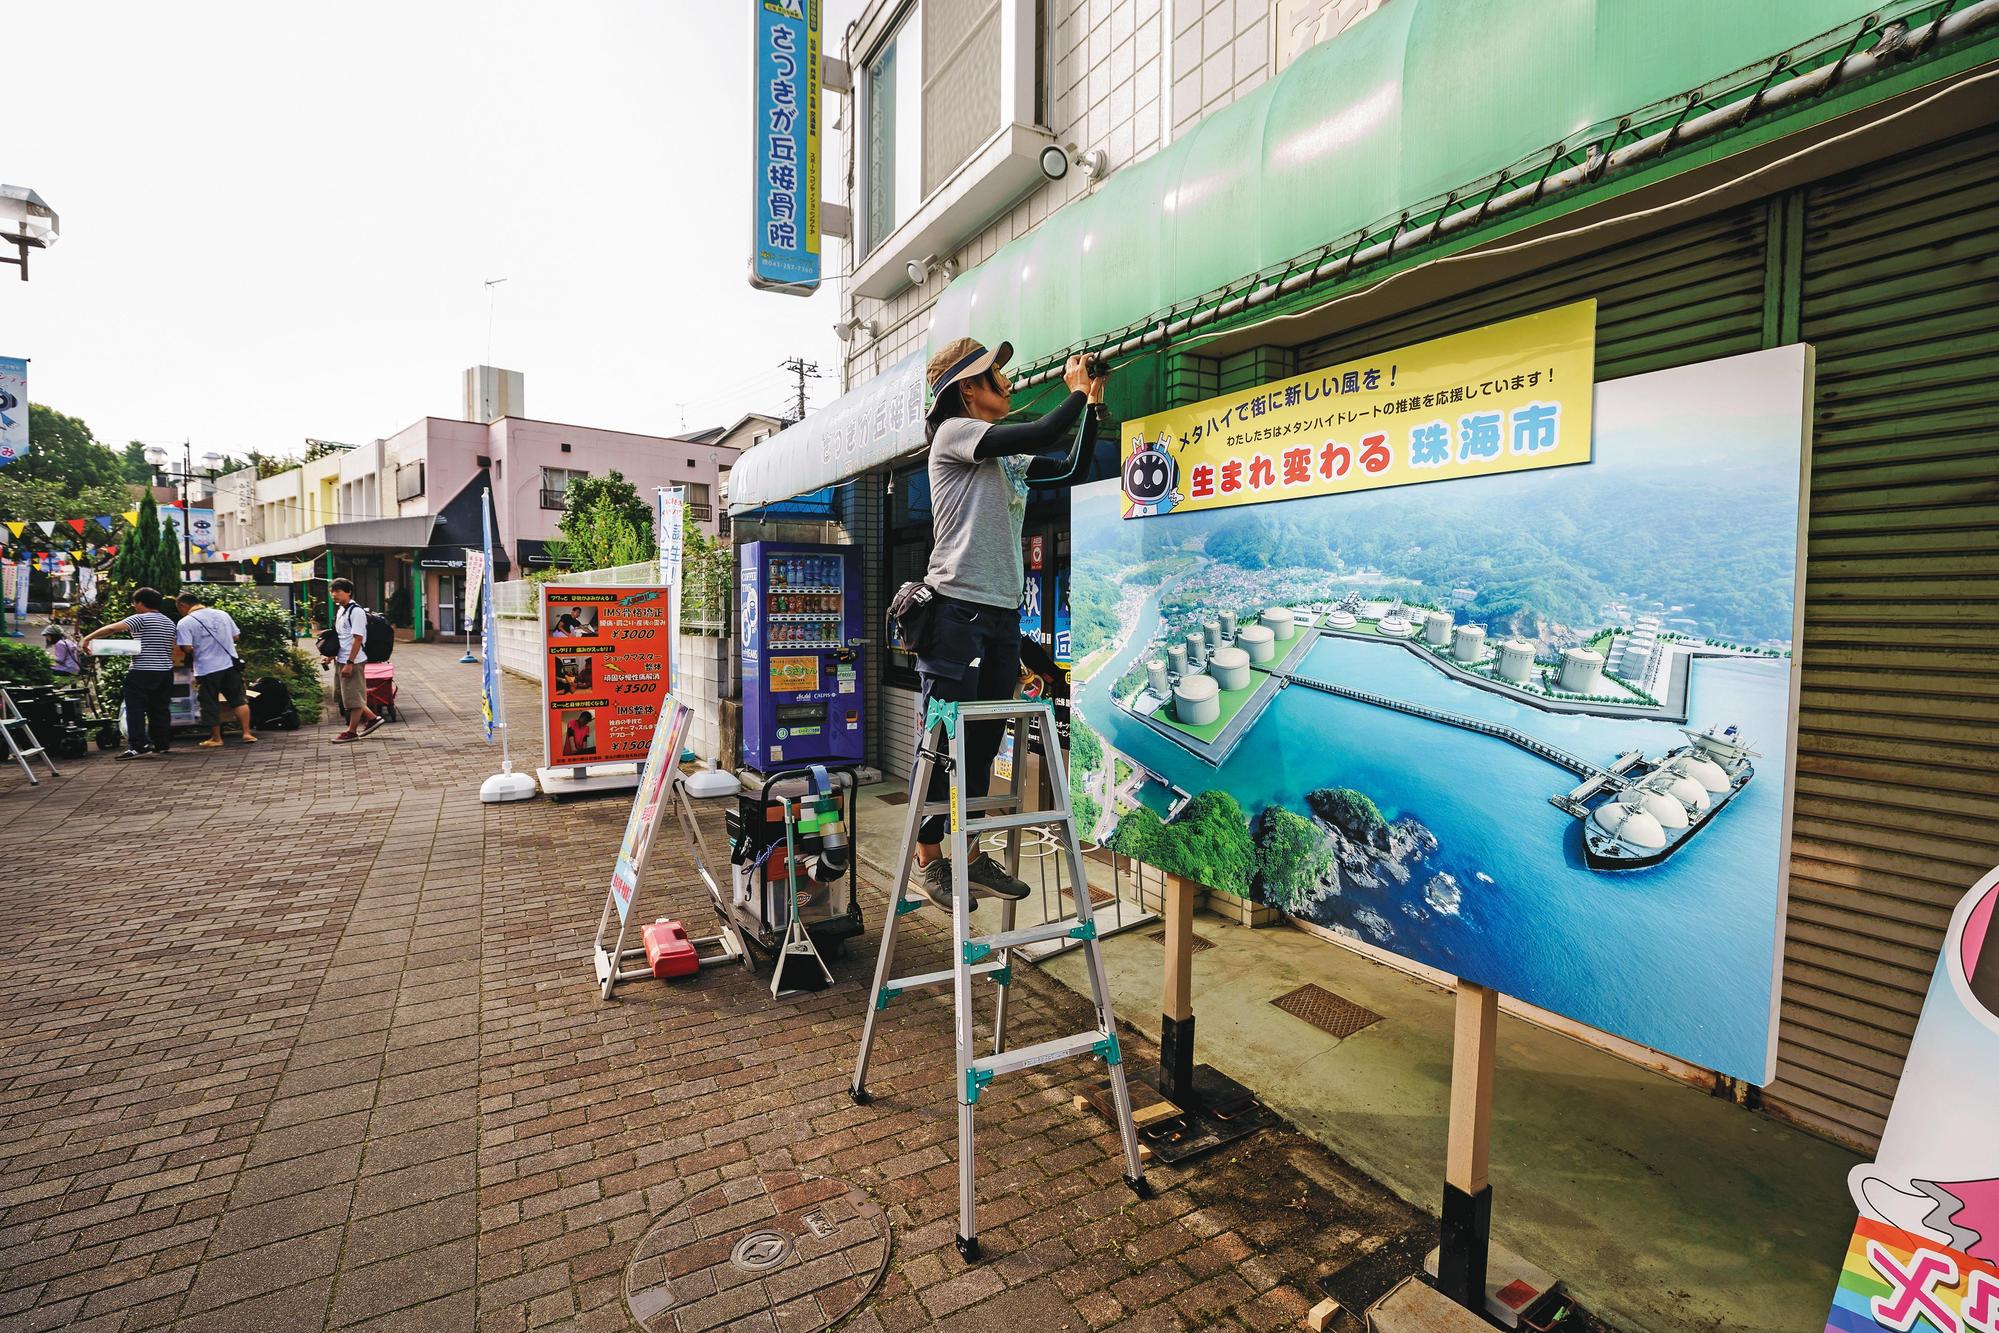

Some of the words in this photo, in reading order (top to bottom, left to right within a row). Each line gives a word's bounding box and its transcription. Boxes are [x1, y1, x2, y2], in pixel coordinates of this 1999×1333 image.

[770, 25, 797, 249] さつきが丘接骨院
[1178, 364, 1398, 452] メタハイで街に新しい風を！
[1226, 368, 1556, 447] わたしたちはメタンハイドレートの推進を応援しています！
[1191, 434, 1391, 498] 生まれ変わる
[1412, 404, 1558, 465] 珠海市
[612, 629, 655, 639] ¥3000
[615, 683, 656, 693] ¥3500
